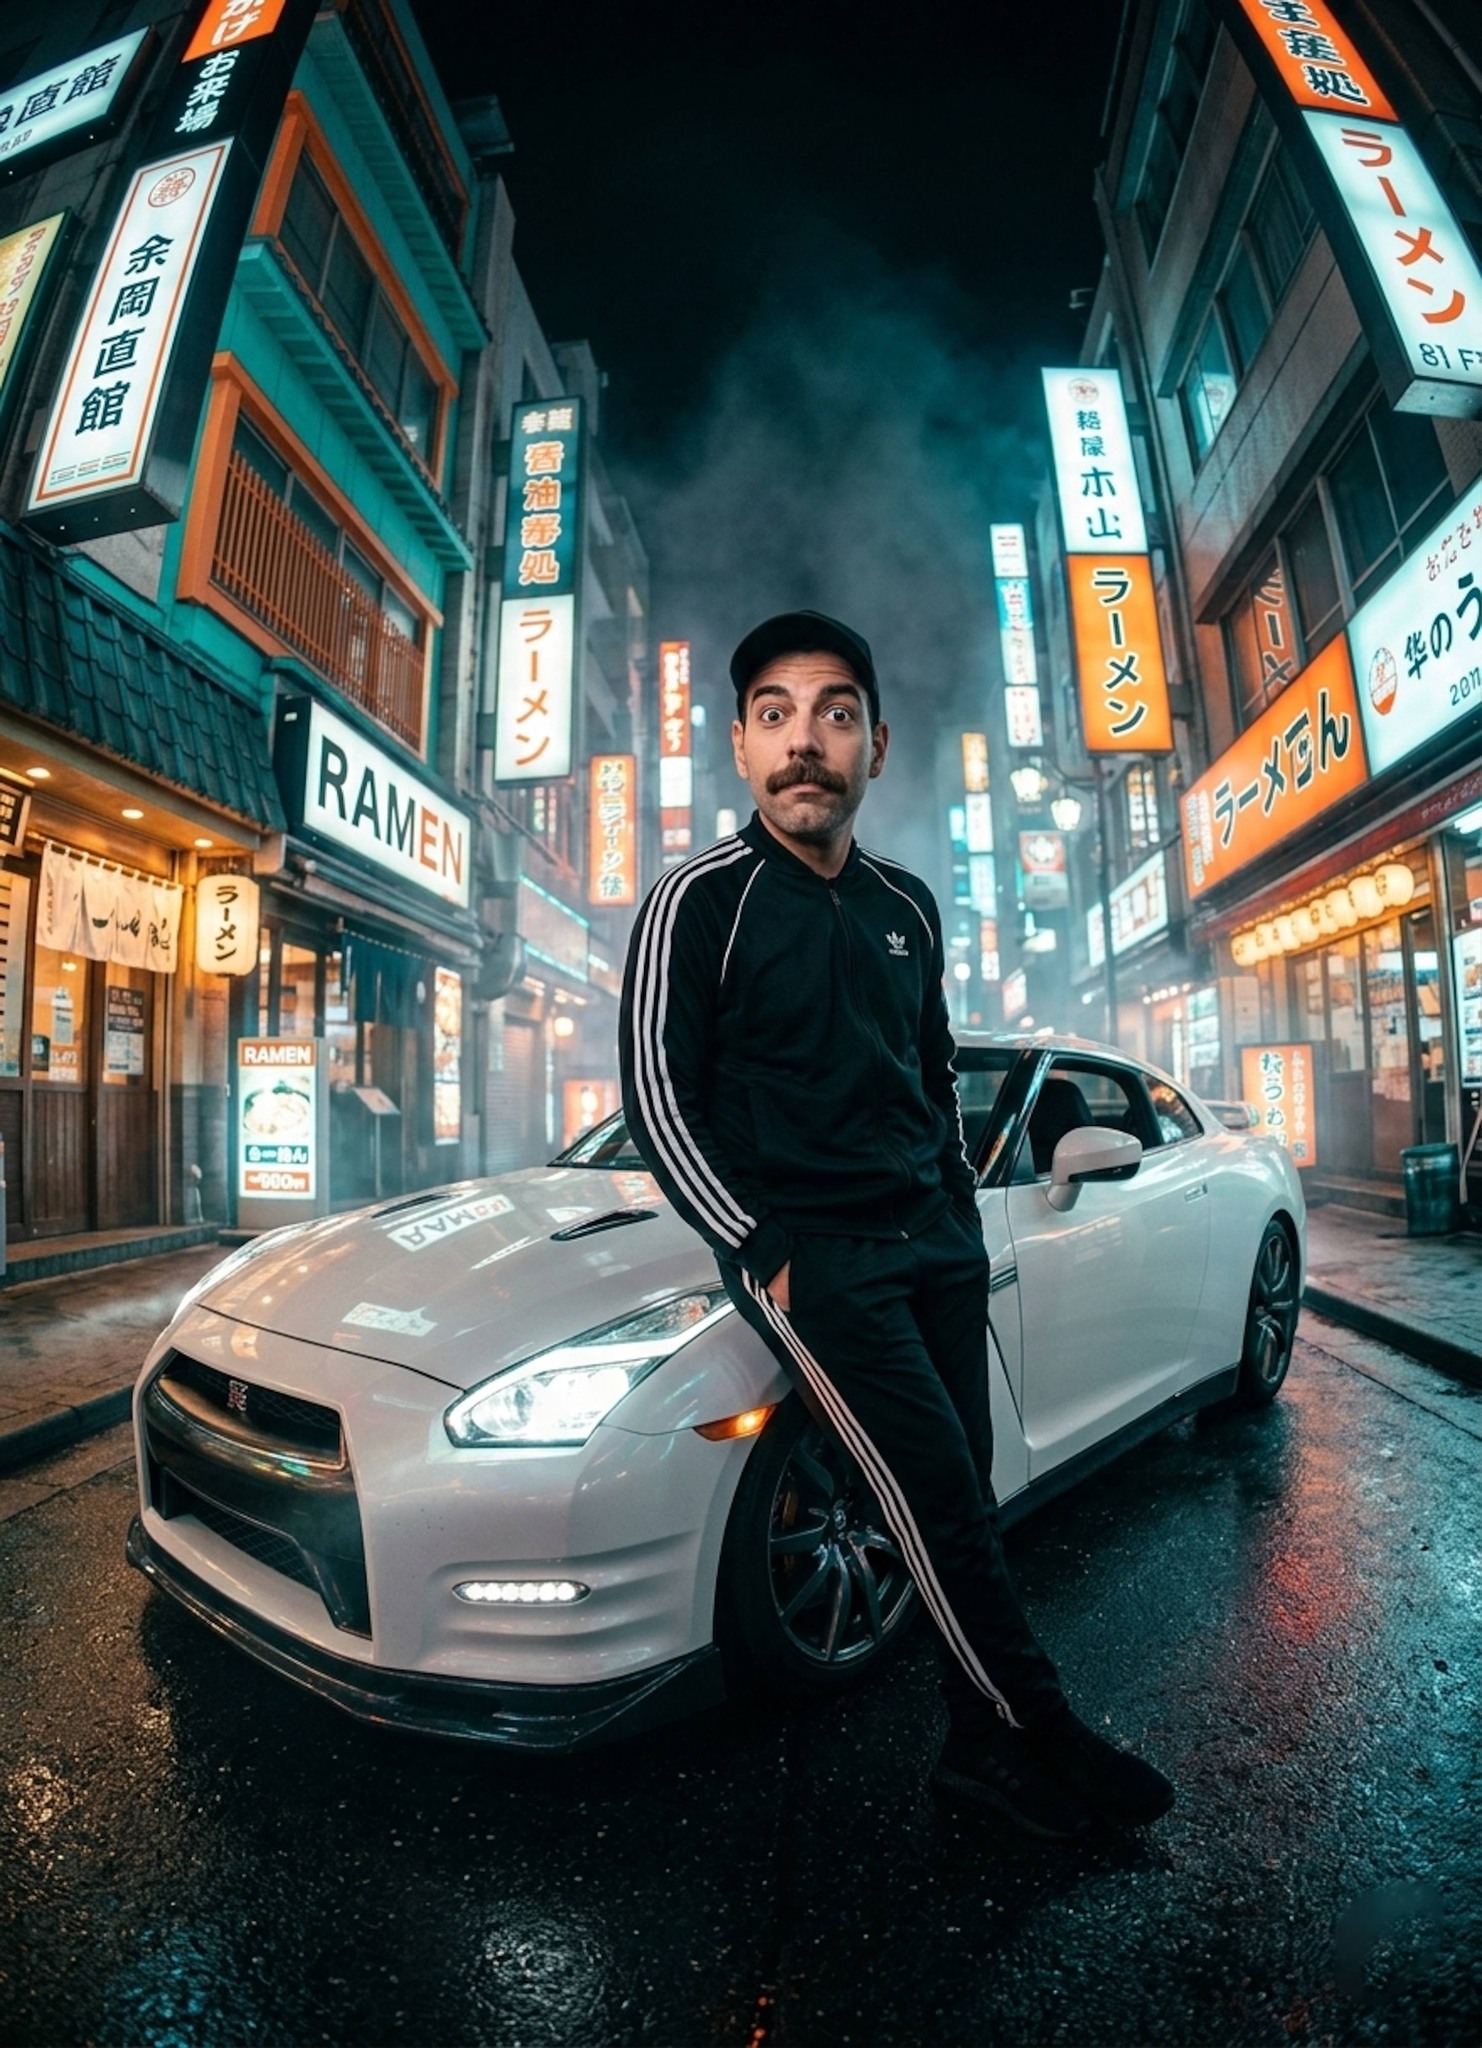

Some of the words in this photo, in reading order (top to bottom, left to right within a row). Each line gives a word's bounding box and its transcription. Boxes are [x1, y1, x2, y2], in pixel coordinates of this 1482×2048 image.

[174, 50, 240, 132] お来場
[1341, 127, 1465, 324] ラーメン
[515, 609, 554, 767] ラーメン
[1093, 566, 1148, 737] ラーメン
[318, 734, 462, 885] RAMEN
[215, 885, 239, 961] ラーメン
[244, 1046, 311, 1065] RAMEN
